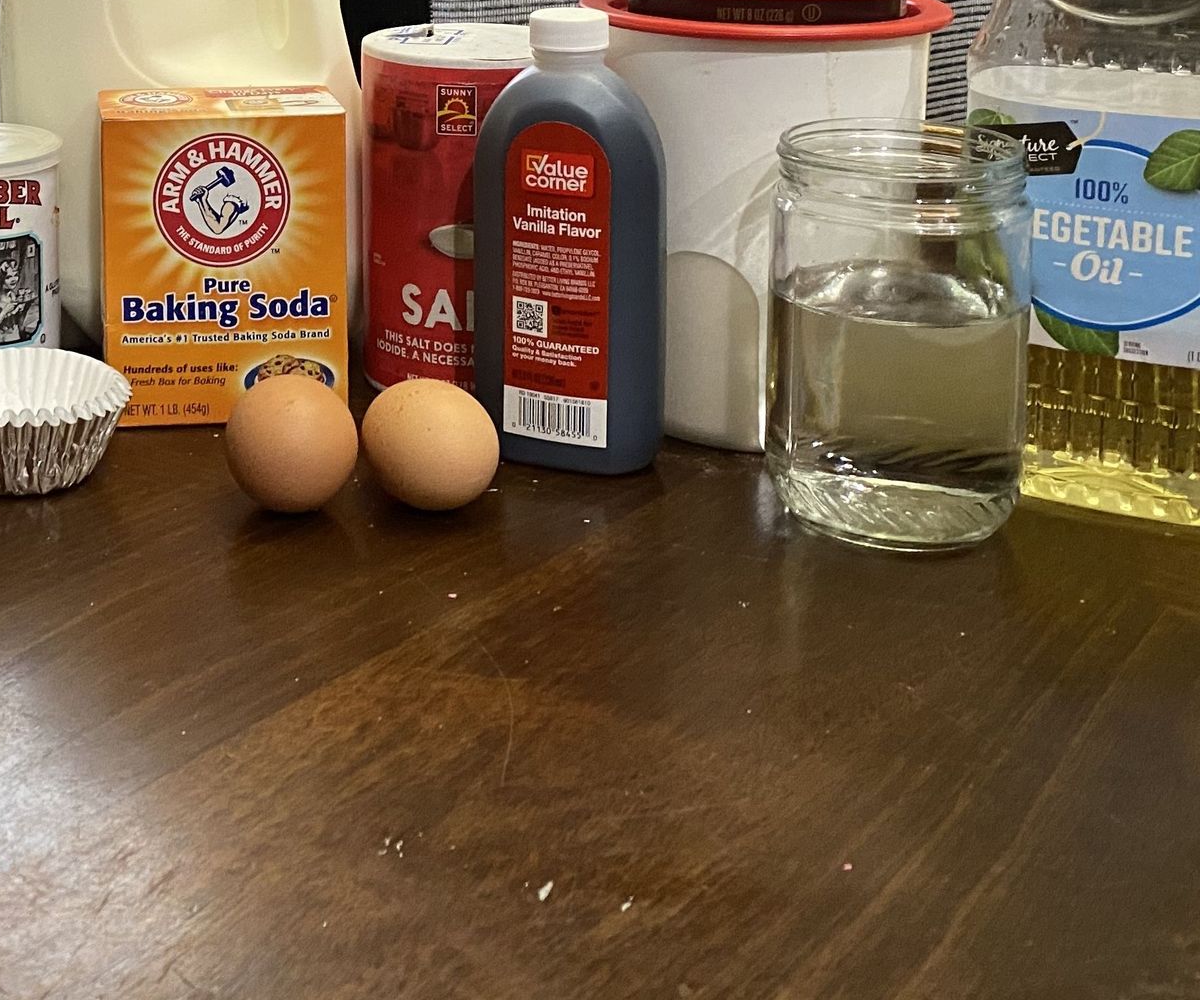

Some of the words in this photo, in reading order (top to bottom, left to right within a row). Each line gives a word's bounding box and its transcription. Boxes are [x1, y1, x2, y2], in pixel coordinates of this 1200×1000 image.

[717, 8, 731, 19] NET
[732, 8, 745, 20] WT
[440, 88, 473, 96] SUNNY
[440, 124, 473, 132] SELECT
[1028, 152, 1058, 162] ECT
[161, 161, 191, 214] ARM
[187, 149, 208, 168] &
[208, 140, 283, 210] HAMMER
[525, 174, 587, 192] corner
[1075, 177, 1129, 204] 100%
[527, 203, 587, 223] Imitation
[512, 216, 555, 235] Vanilla
[559, 222, 602, 239] Flavor
[1032, 208, 1195, 258] EGETABLE
[175, 225, 189, 241] THE
[188, 237, 232, 255] STANDARD
[234, 242, 244, 252] OF
[244, 222, 269, 248] PURITY
[1070, 250, 1124, 285] Oil
[204, 278, 251, 293] Pure
[122, 292, 240, 328] Baking
[249, 289, 330, 320] Soda
[402, 283, 475, 332] SA
[122, 335, 172, 344] America's
[176, 334, 188, 343] #1
[192, 333, 229, 343] Trusted
[233, 332, 267, 342] Baking
[271, 331, 296, 340] Soda
[300, 329, 330, 338] Brand
[385, 329, 404, 344] THIS
[405, 336, 430, 350] SALT
[434, 341, 467, 353] DOES
[512, 336, 534, 346] 100%
[536, 340, 600, 355] GUARANTEED
[512, 344, 534, 355] Quality
[411, 350, 420, 361] A
[422, 352, 475, 367] NECESSA
[520, 353, 534, 361] your
[534, 356, 557, 365] money
[123, 364, 173, 374] Hundreds
[176, 363, 188, 373] of
[190, 365, 213, 373] uses
[216, 362, 239, 372] like:
[130, 377, 155, 387] Fresh
[158, 377, 175, 386] Box
[178, 376, 191, 386] for
[194, 376, 226, 386] Baking
[124, 404, 140, 416] NET
[142, 404, 159, 416] WT.
[160, 404, 165, 416] 1
[183, 403, 210, 417] (454g)
[526, 424, 552, 435] 21130
